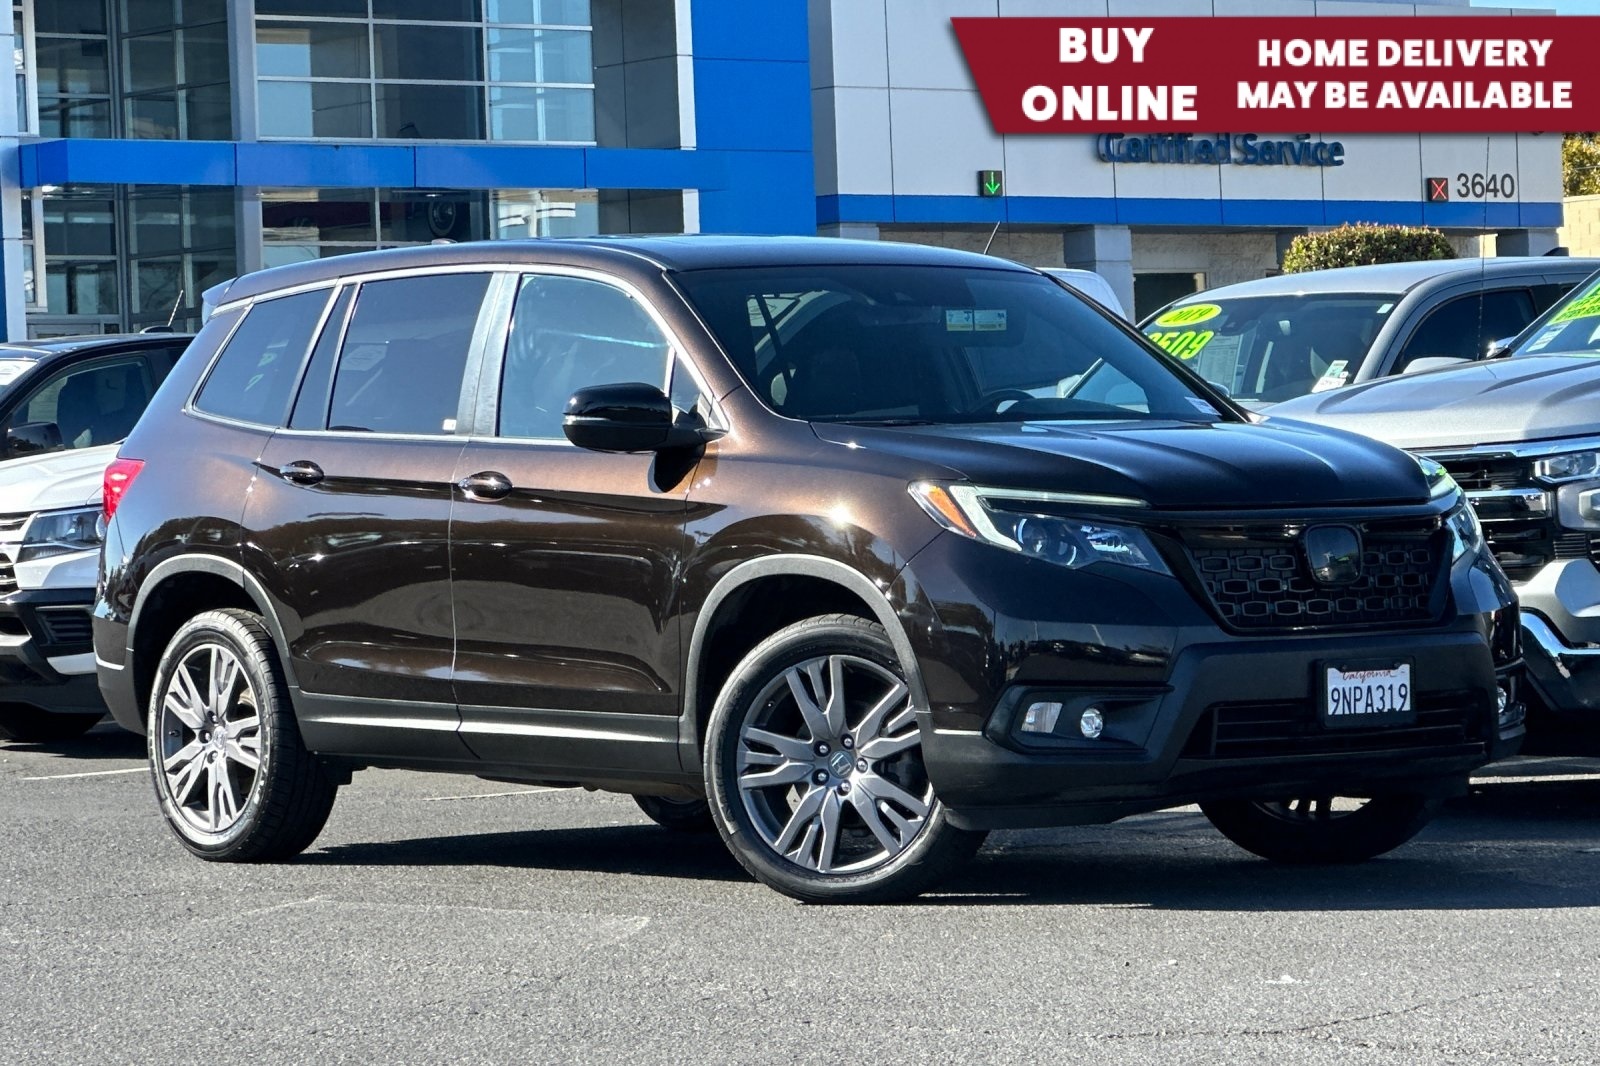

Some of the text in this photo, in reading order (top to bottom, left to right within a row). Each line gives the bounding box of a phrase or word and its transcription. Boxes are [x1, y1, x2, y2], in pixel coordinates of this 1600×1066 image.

[1098, 133, 1345, 166] Certified Service
[1456, 173, 1515, 198] 3640
[1342, 670, 1396, 683] California
[1331, 683, 1408, 715] 9NPA319
